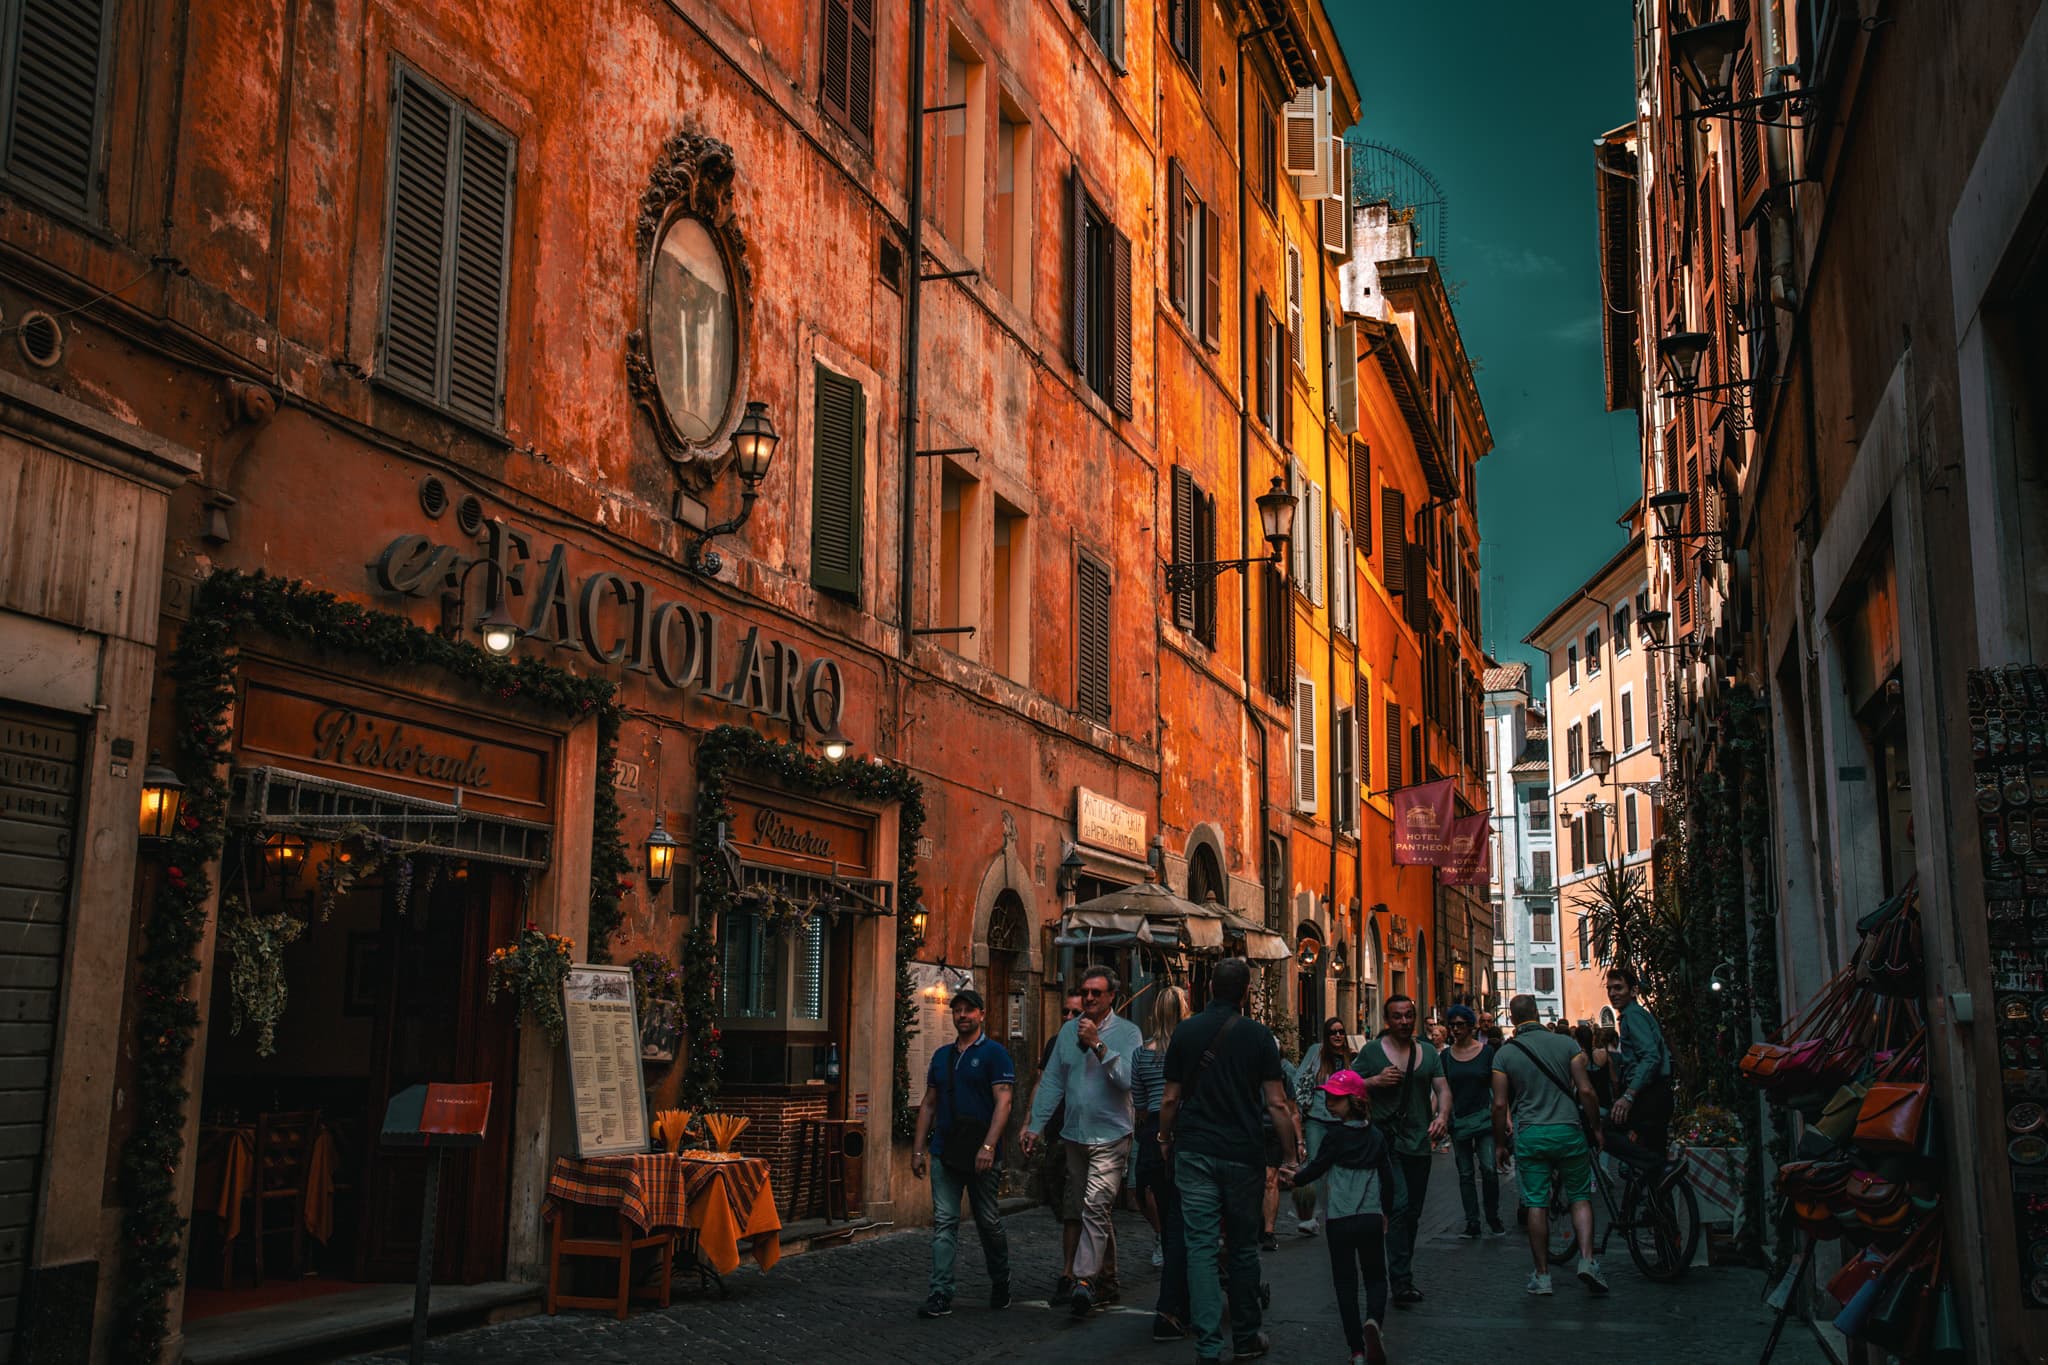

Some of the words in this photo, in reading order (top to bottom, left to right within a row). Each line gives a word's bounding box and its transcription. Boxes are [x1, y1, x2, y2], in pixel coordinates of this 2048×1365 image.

[482, 520, 846, 734] FACIOLARO
[312, 706, 492, 788] Ristorante
[752, 807, 836, 858] Pizzeria
[1395, 843, 1451, 852] PANTHEON
[1406, 833, 1440, 841] HOTEL
